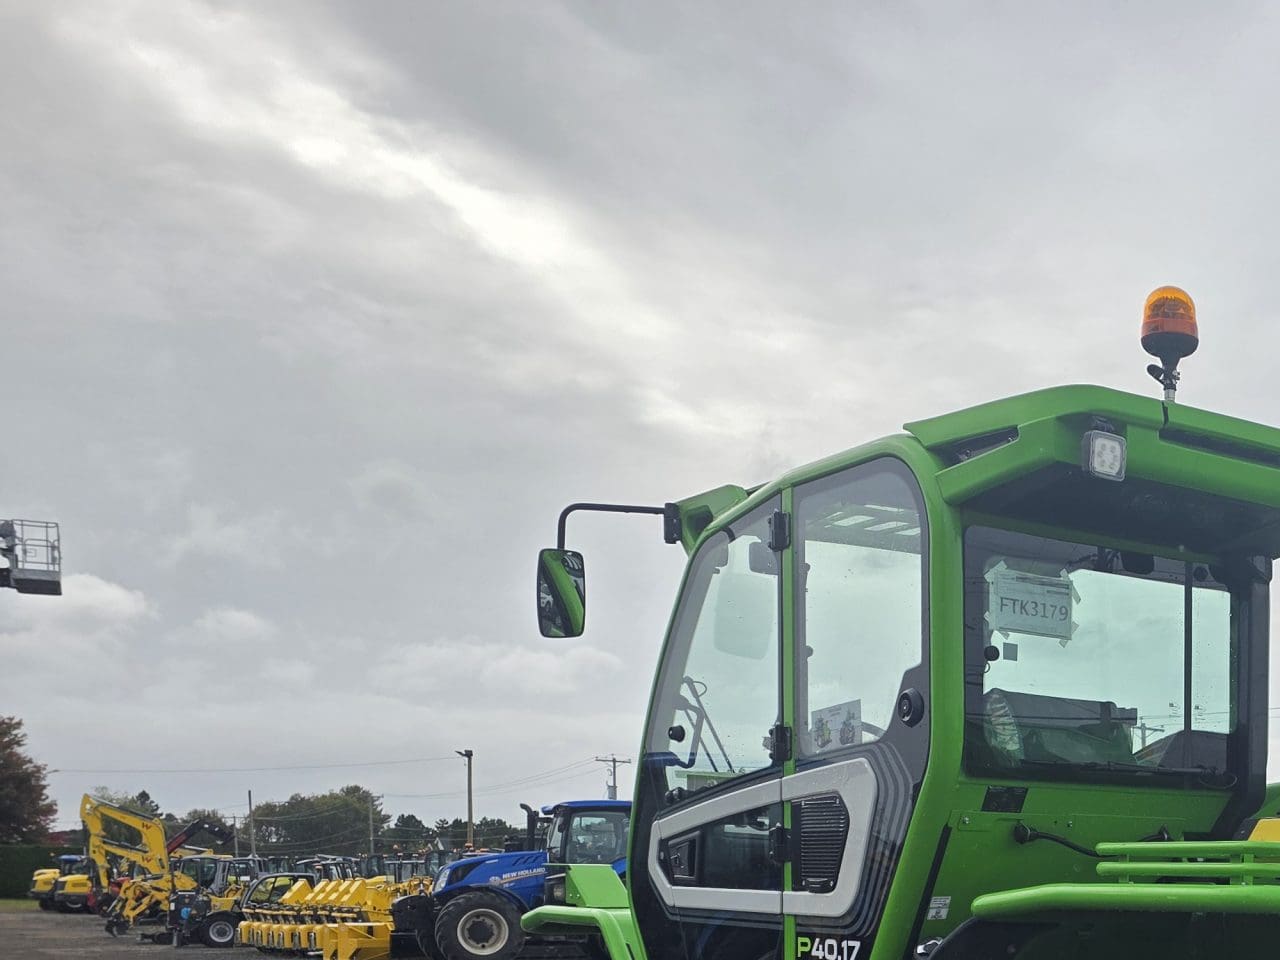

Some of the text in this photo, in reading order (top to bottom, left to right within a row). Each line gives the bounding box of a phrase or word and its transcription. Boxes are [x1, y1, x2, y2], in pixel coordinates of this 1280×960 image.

[1000, 597, 1069, 621] FTK3179
[502, 867, 546, 880] NEW HOLLAND
